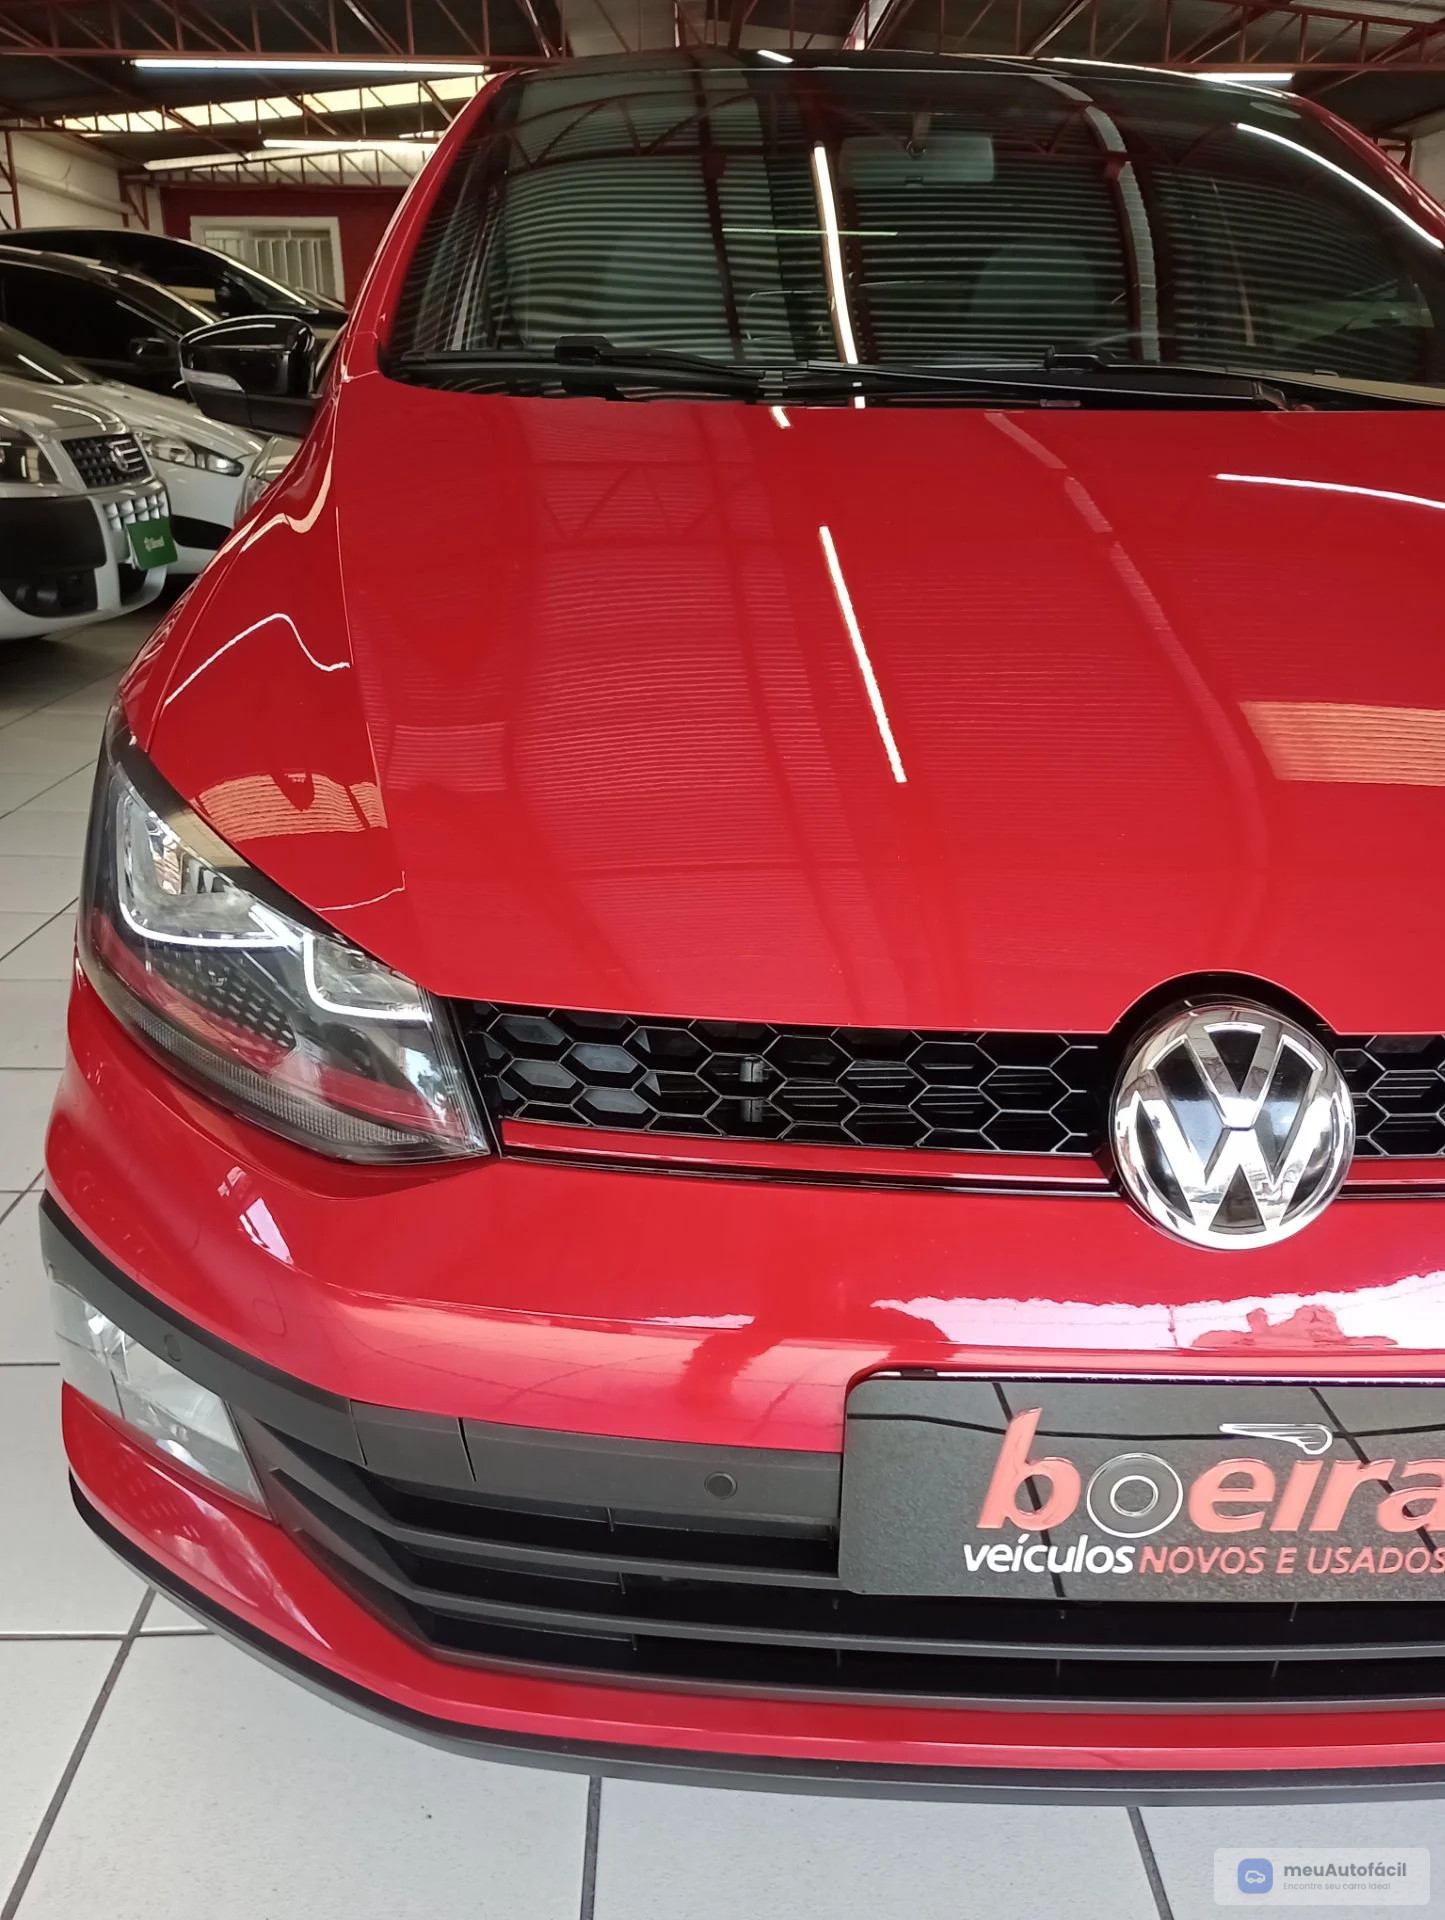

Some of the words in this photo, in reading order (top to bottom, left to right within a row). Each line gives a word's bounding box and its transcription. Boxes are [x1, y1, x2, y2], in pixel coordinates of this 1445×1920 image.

[1114, 1008, 1350, 1246] VW
[976, 1406, 1445, 1537] boeira
[963, 1533, 1136, 1574] veículos
[1139, 1546, 1267, 1574] NOVOS
[1275, 1546, 1298, 1574] E
[1307, 1546, 1445, 1574] USADOS
